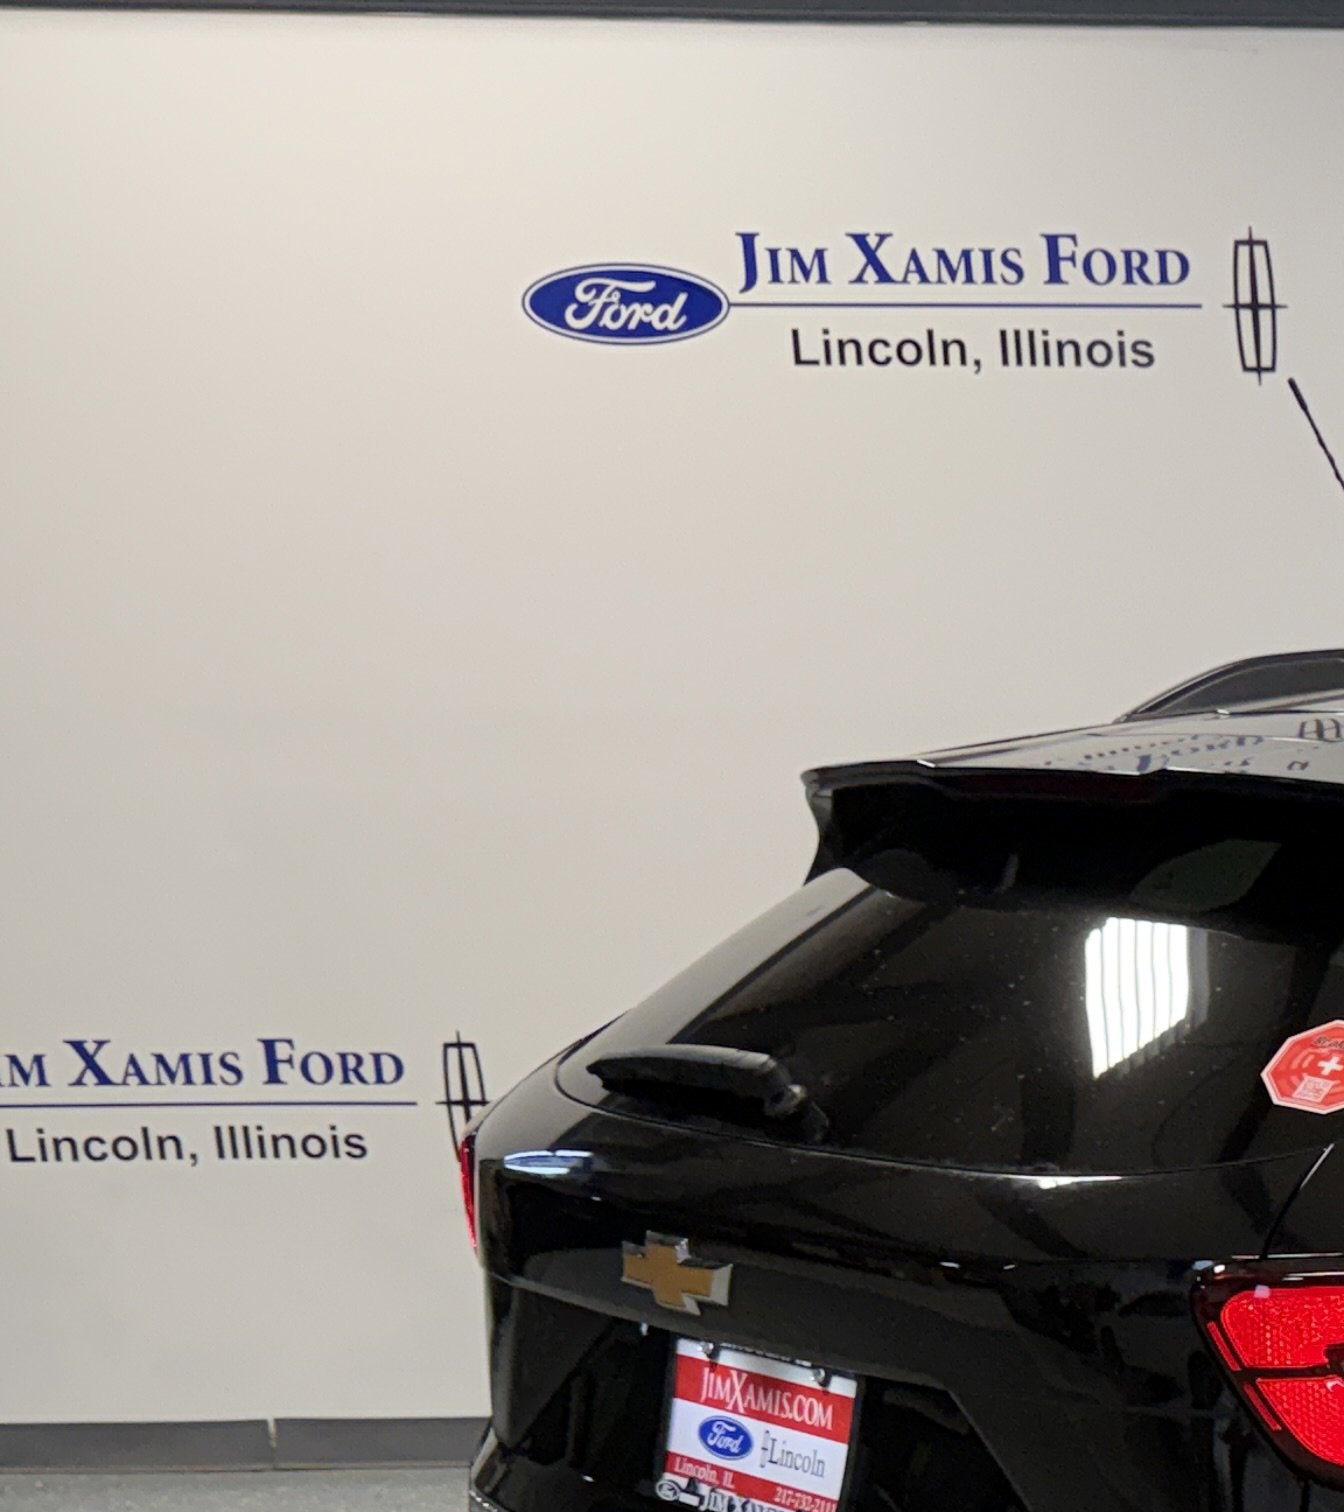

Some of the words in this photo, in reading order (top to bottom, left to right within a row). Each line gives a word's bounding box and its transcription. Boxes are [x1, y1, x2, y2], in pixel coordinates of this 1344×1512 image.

[734, 231, 830, 294] JIM
[845, 232, 1025, 287] XAMIS
[1041, 233, 1191, 287] FORD
[563, 276, 688, 333] Ford
[791, 328, 984, 377] Lincoln,
[999, 328, 1156, 369] Illinois
[63, 1039, 244, 1087] XAMIS
[257, 1037, 404, 1087] FORD
[5, 1126, 198, 1167] Lincoln,
[214, 1125, 368, 1161] Illinois
[700, 1366, 834, 1431] JIMXAMIS.COM
[706, 1420, 743, 1454] Ford
[767, 1438, 826, 1478] Lincoln
[698, 1486, 728, 1512] JIM
